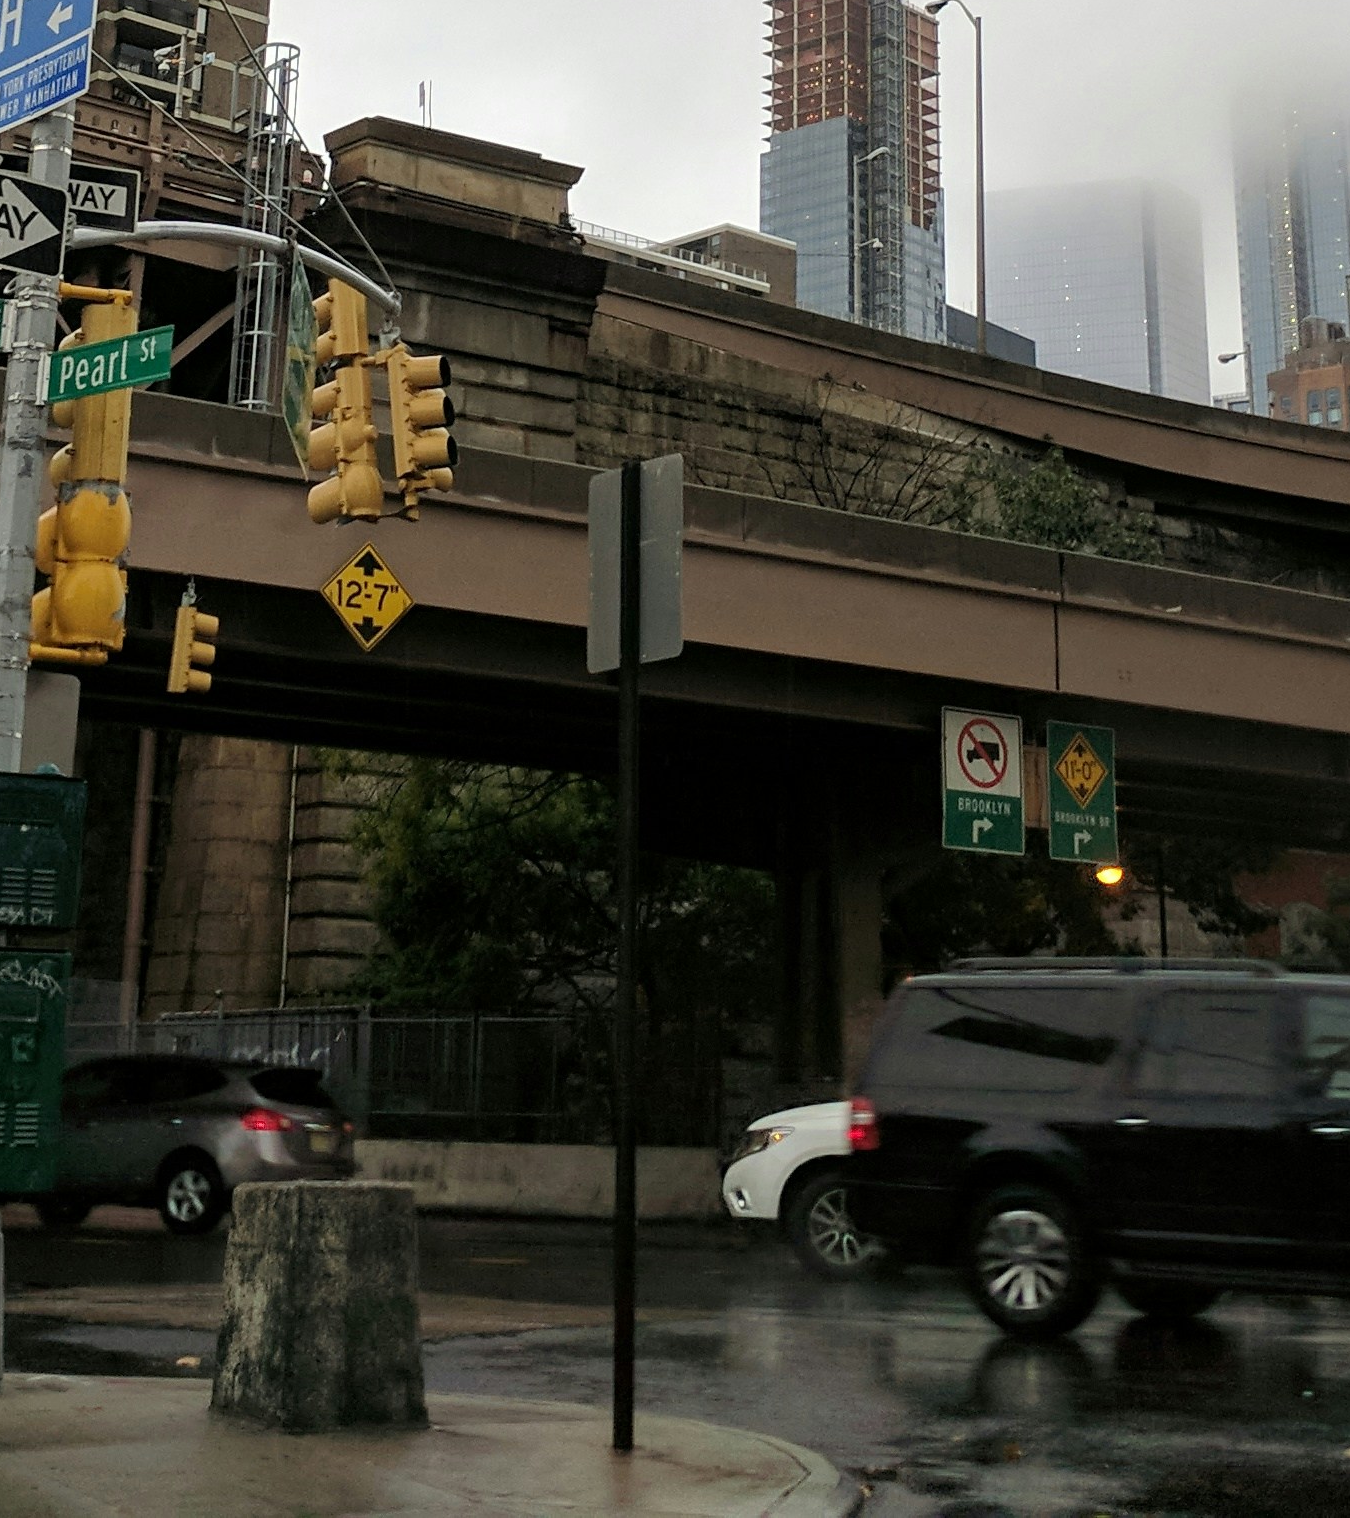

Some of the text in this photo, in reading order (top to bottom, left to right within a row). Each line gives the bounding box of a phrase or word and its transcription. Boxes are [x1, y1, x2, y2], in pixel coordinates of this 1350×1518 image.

[3, 74, 26, 98] YORK
[27, 43, 87, 88] PRESBYTERIAN
[24, 69, 79, 112] MANHATTAN
[68, 183, 116, 211] WAY
[59, 335, 157, 394] Pearl St
[957, 797, 1011, 816] BROOKLYN
[1054, 811, 1095, 827] BROOKLYN
